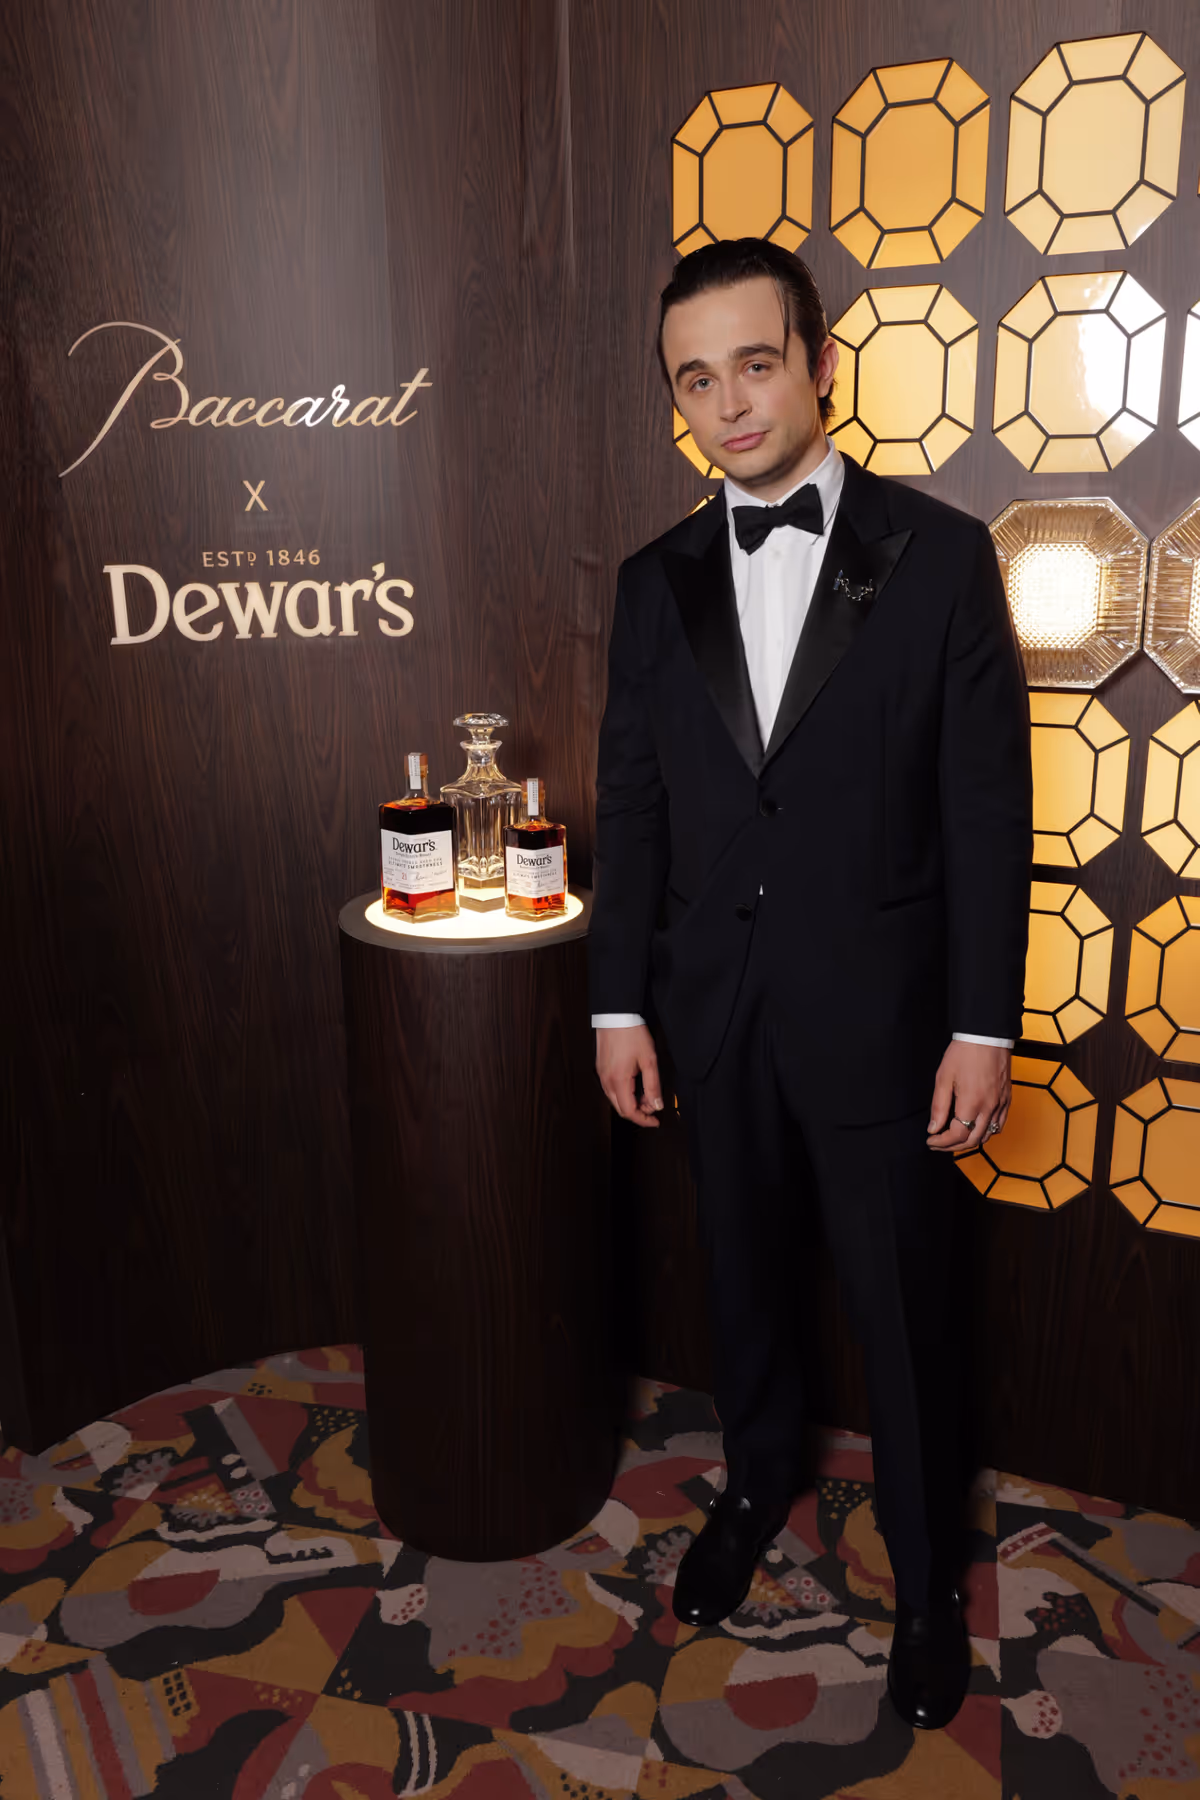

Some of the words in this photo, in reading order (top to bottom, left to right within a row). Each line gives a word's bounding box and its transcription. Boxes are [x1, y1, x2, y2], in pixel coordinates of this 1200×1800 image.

[58, 321, 433, 478] Baccarat
[266, 548, 321, 566] 1846
[102, 562, 415, 646] Dewar's
[392, 837, 436, 854] Dewar's
[516, 853, 553, 867] Dewar's
